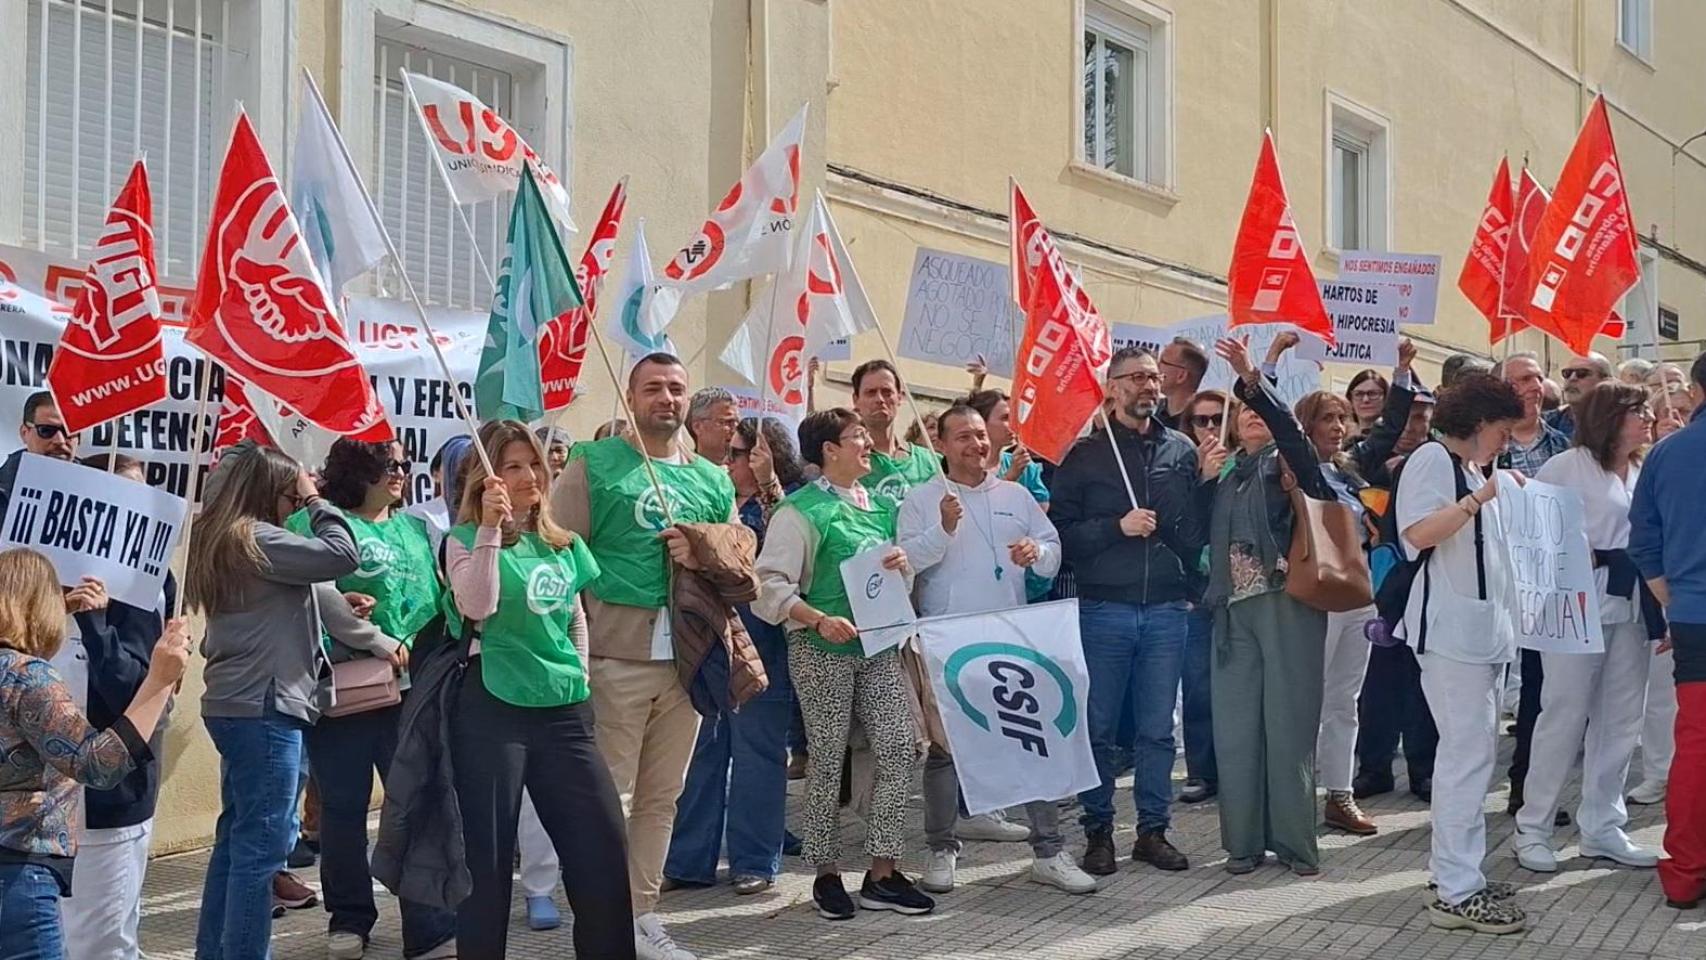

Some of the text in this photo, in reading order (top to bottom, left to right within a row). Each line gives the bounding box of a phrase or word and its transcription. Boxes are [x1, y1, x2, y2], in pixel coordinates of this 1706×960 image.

[423, 101, 535, 161] US
[918, 255, 994, 289] ASQUEADO
[1344, 259, 1358, 272] NOS
[1323, 285, 1378, 304] HARTOS DE
[919, 303, 950, 329] NO
[957, 307, 982, 336] SE
[1337, 314, 1396, 334] HIPOCRESIA
[388, 376, 405, 415] Y
[413, 378, 480, 420] EFEC
[39, 490, 119, 559] BASTA
[119, 509, 150, 569] YA
[143, 520, 173, 577] !!!
[988, 660, 1049, 758] CSIF
